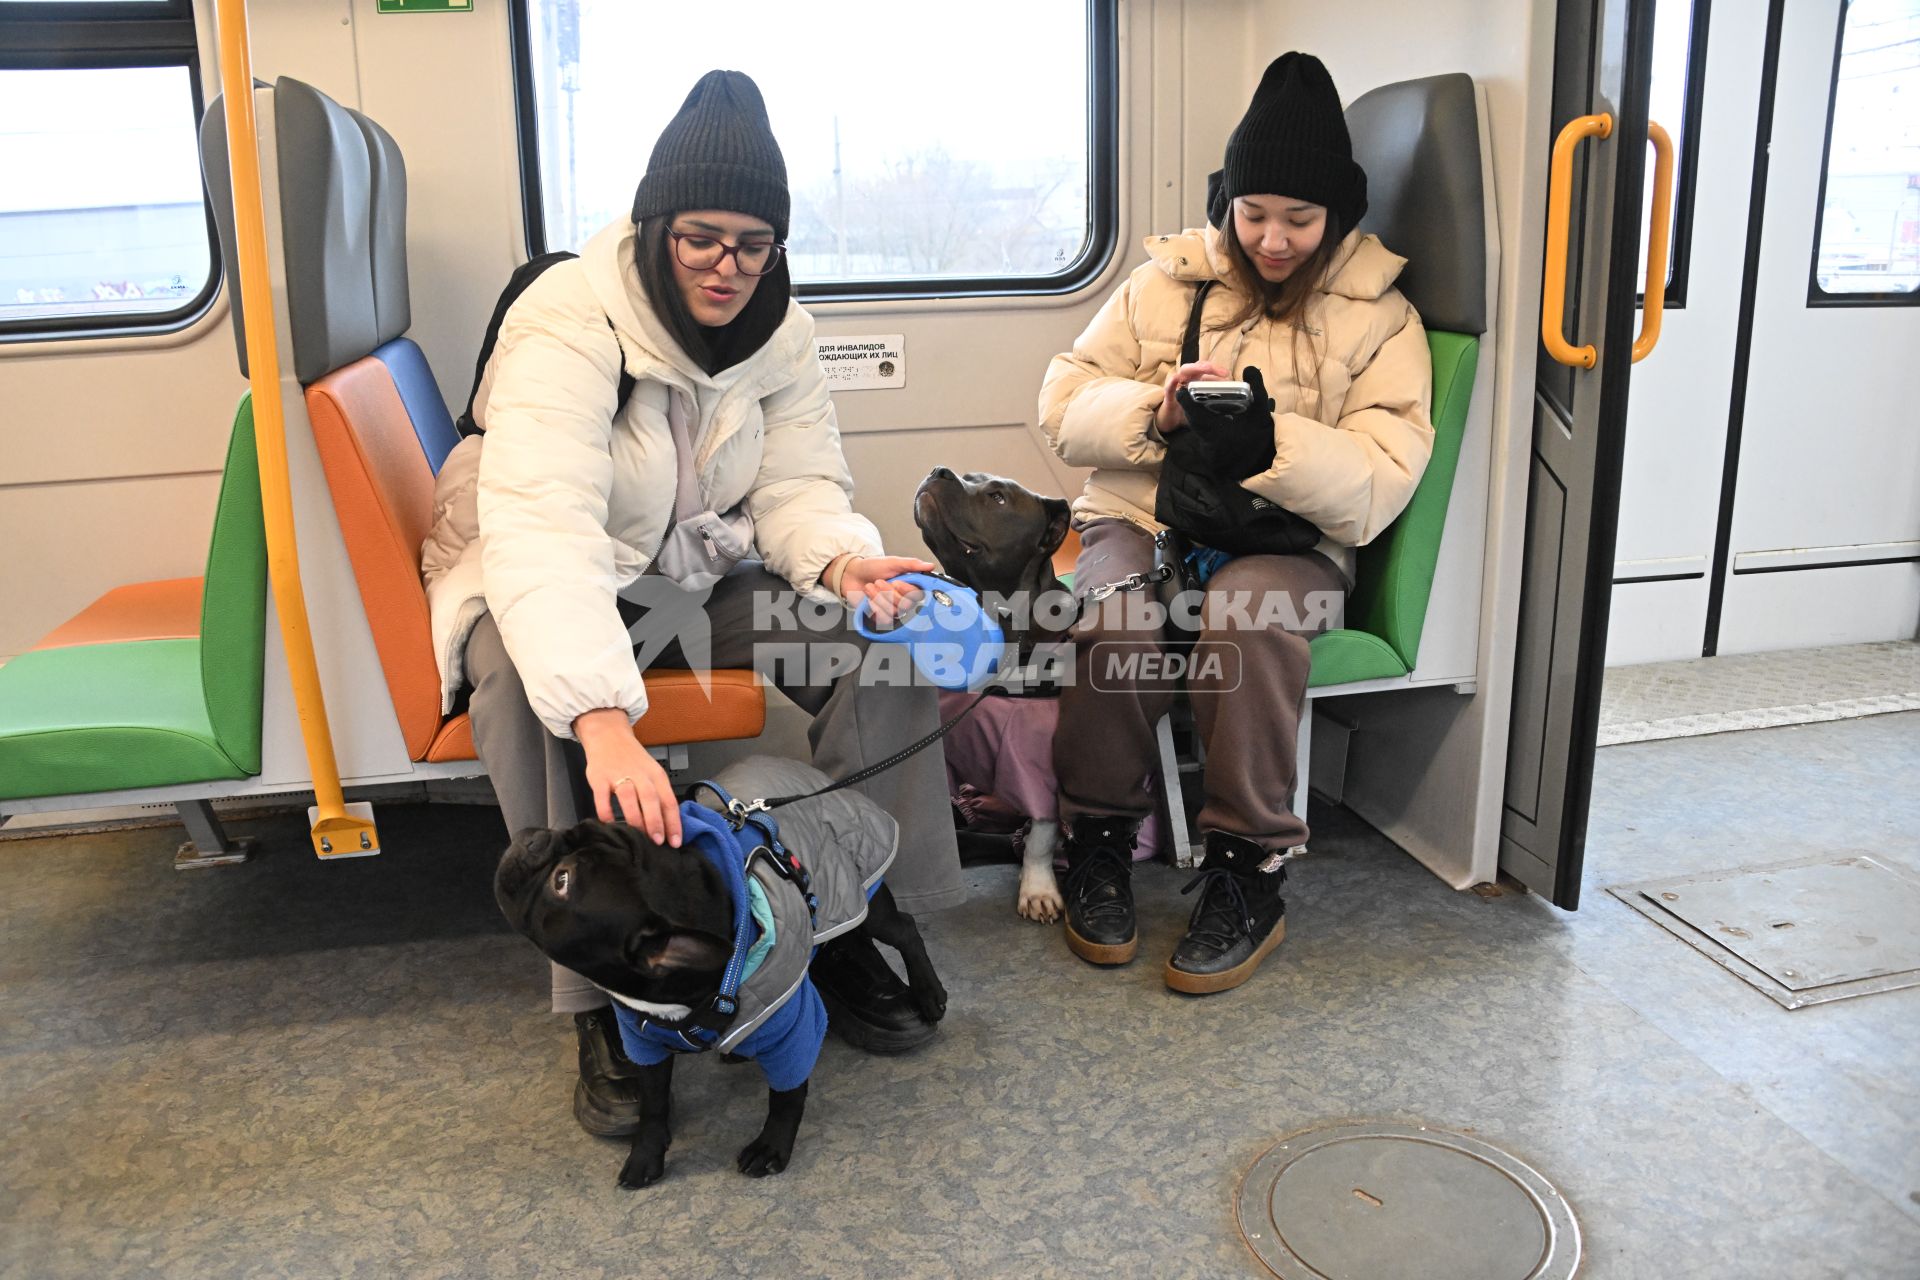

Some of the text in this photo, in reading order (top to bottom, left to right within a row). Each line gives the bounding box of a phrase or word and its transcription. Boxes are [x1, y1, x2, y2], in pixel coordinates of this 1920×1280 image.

[819, 343, 885, 353] ДЛЯ ИНВАЛИДОВ
[882, 351, 898, 359] ЛИЦ
